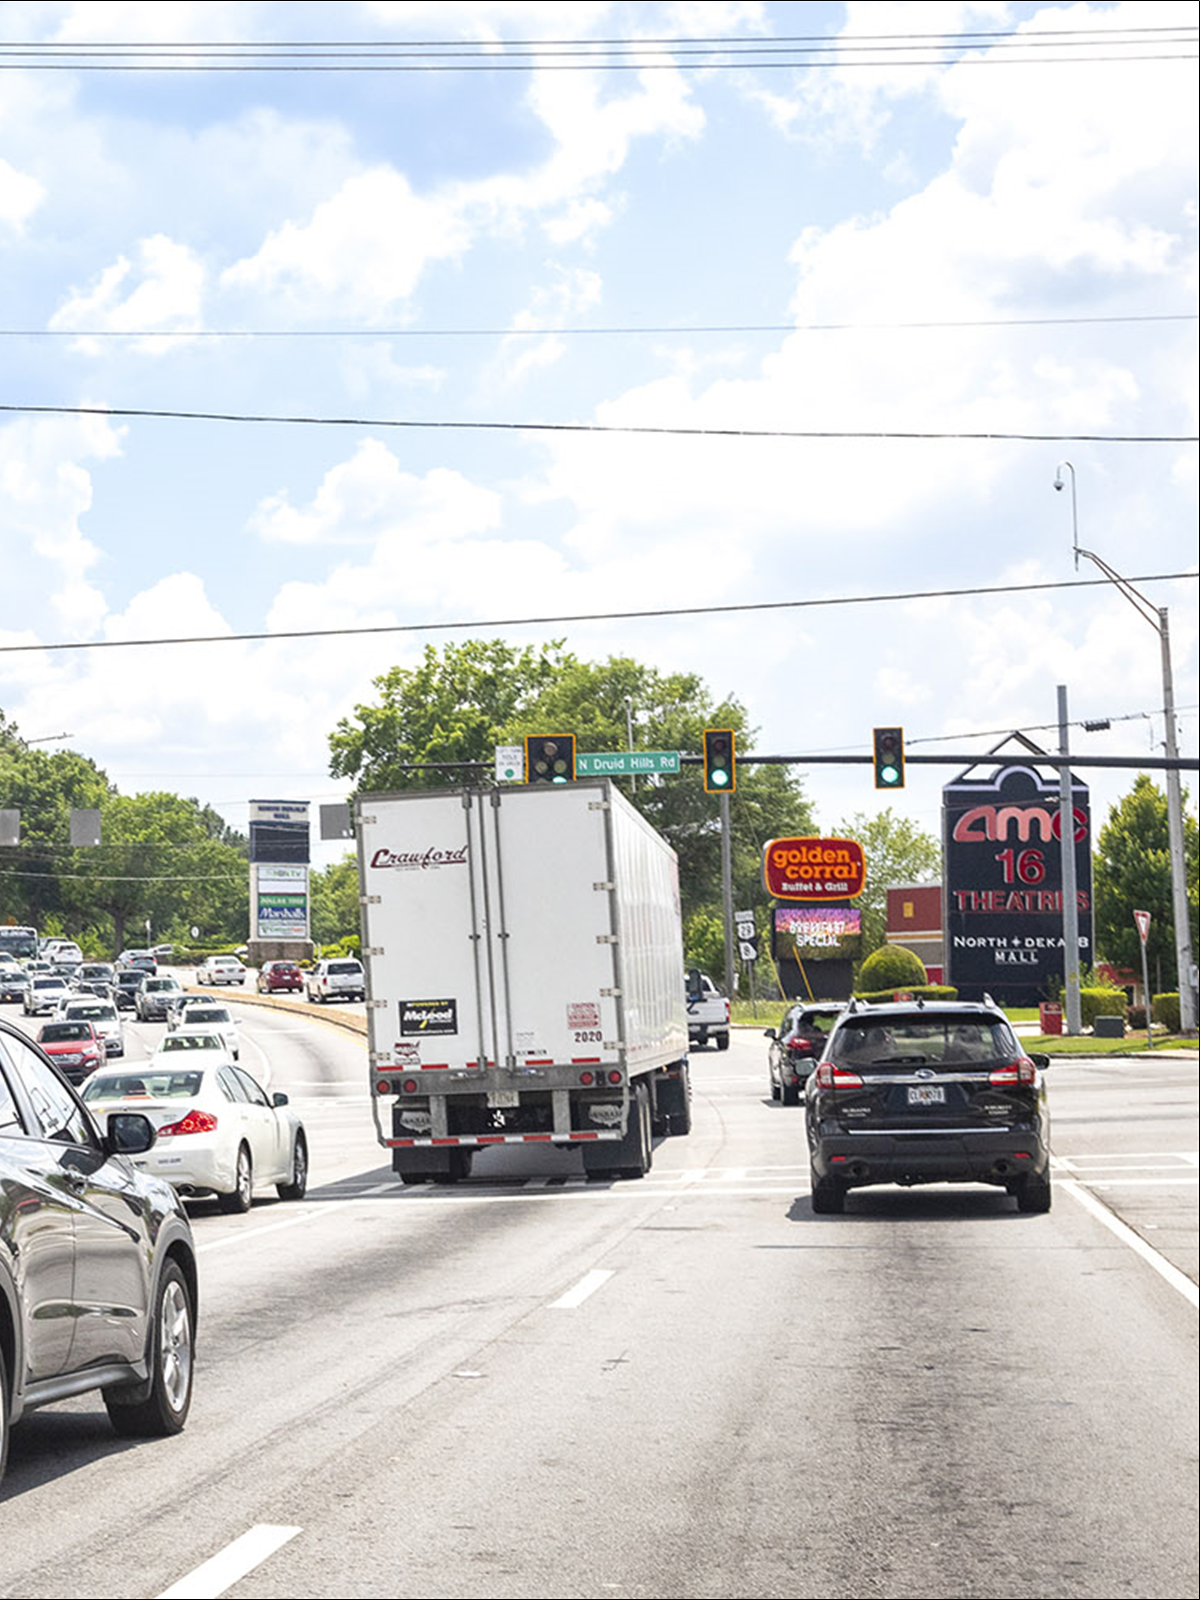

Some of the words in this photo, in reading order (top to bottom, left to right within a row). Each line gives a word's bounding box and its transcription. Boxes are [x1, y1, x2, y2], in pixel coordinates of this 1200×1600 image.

[578, 759, 588, 771] N
[593, 758, 625, 770] Druid
[630, 757, 655, 769] Hills
[660, 756, 676, 768] Rd
[370, 844, 469, 870] Crawford
[772, 845, 851, 869] golden
[785, 860, 858, 879] corral
[995, 848, 1046, 884] 16
[781, 882, 813, 892] Buffet
[814, 882, 823, 892] &
[824, 882, 849, 892] Grill
[795, 933, 842, 948] SPECIAL
[953, 936, 1008, 948] NORTH
[1024, 936, 1090, 948] DEKAB
[994, 951, 1039, 963] MALL
[403, 1008, 453, 1021] McLeod
[574, 1030, 603, 1043] 2020
